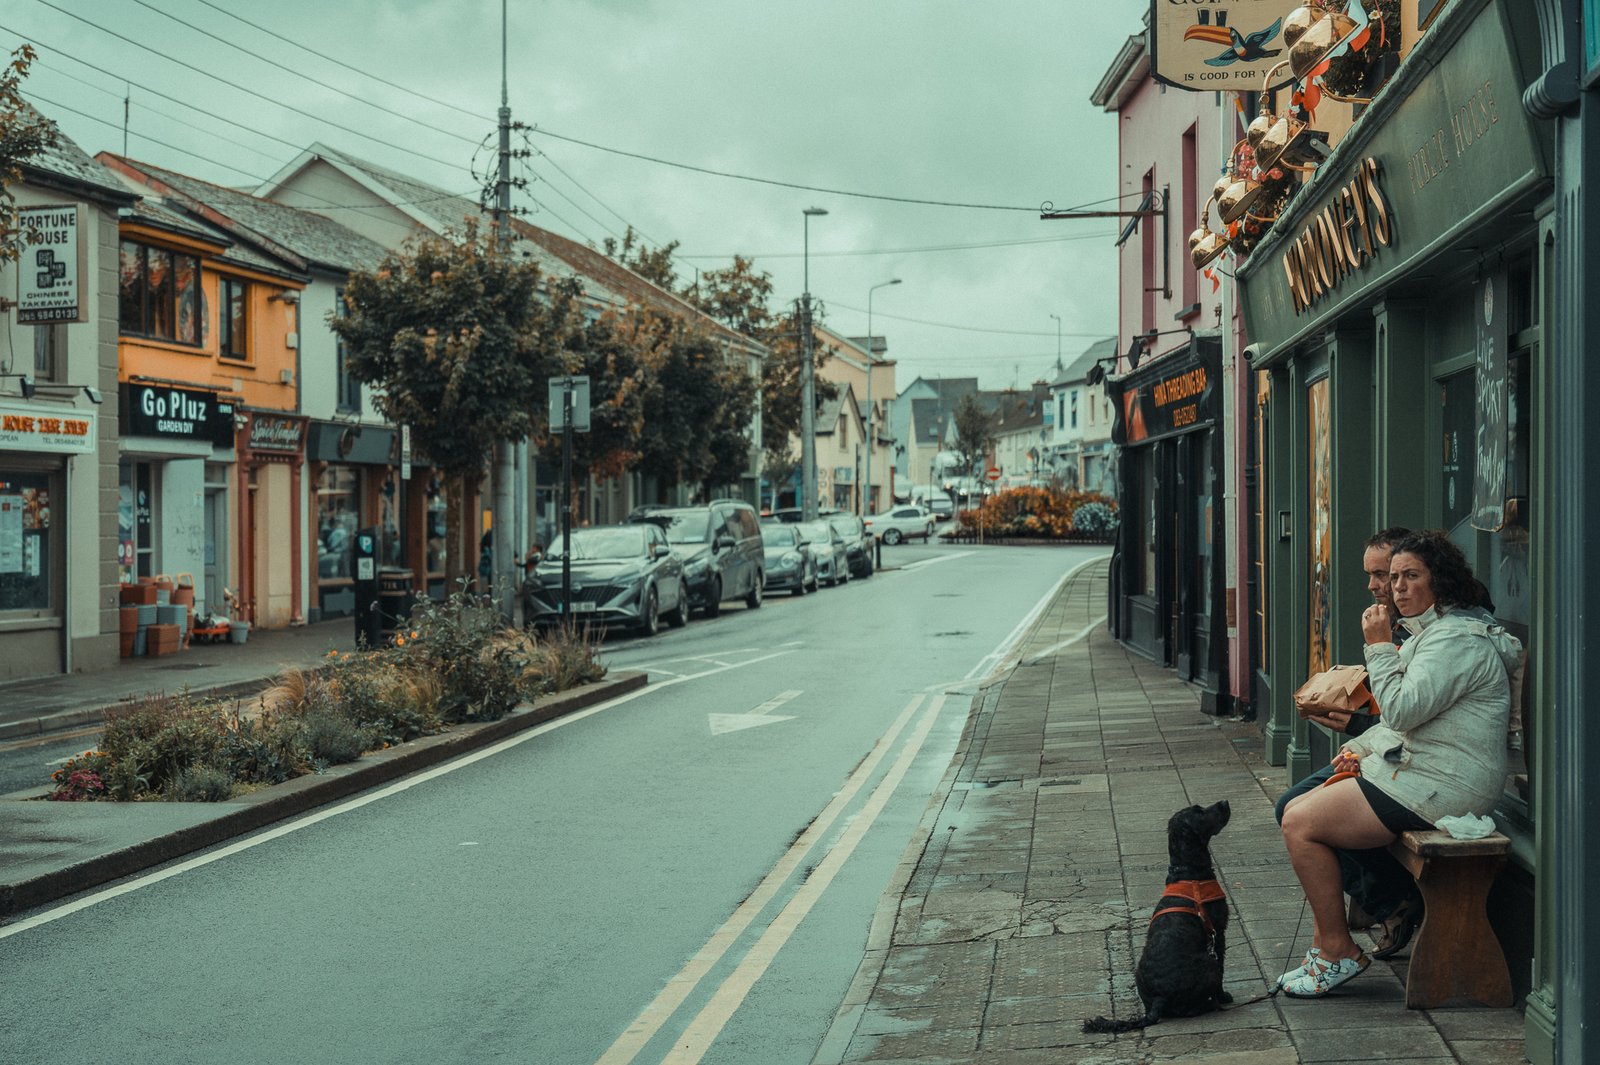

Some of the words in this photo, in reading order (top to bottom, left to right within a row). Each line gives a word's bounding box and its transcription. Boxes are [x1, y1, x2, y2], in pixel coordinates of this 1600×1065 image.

[1184, 73, 1194, 81] IS
[1200, 72, 1229, 81] GOOD
[1234, 70, 1256, 79] FOR
[1261, 68, 1283, 77] YU
[1408, 128, 1448, 194] PUBLIC
[1450, 80, 1498, 157] HOUSE
[20, 213, 76, 228] FORTUNE
[26, 291, 70, 299] CHINESE
[21, 300, 75, 308] TAKEAWAY
[1477, 367, 1504, 424] SPORT
[143, 387, 166, 417] Go
[169, 391, 207, 421] Pluz
[158, 419, 183, 433] GARDEN
[183, 421, 194, 434] DIY
